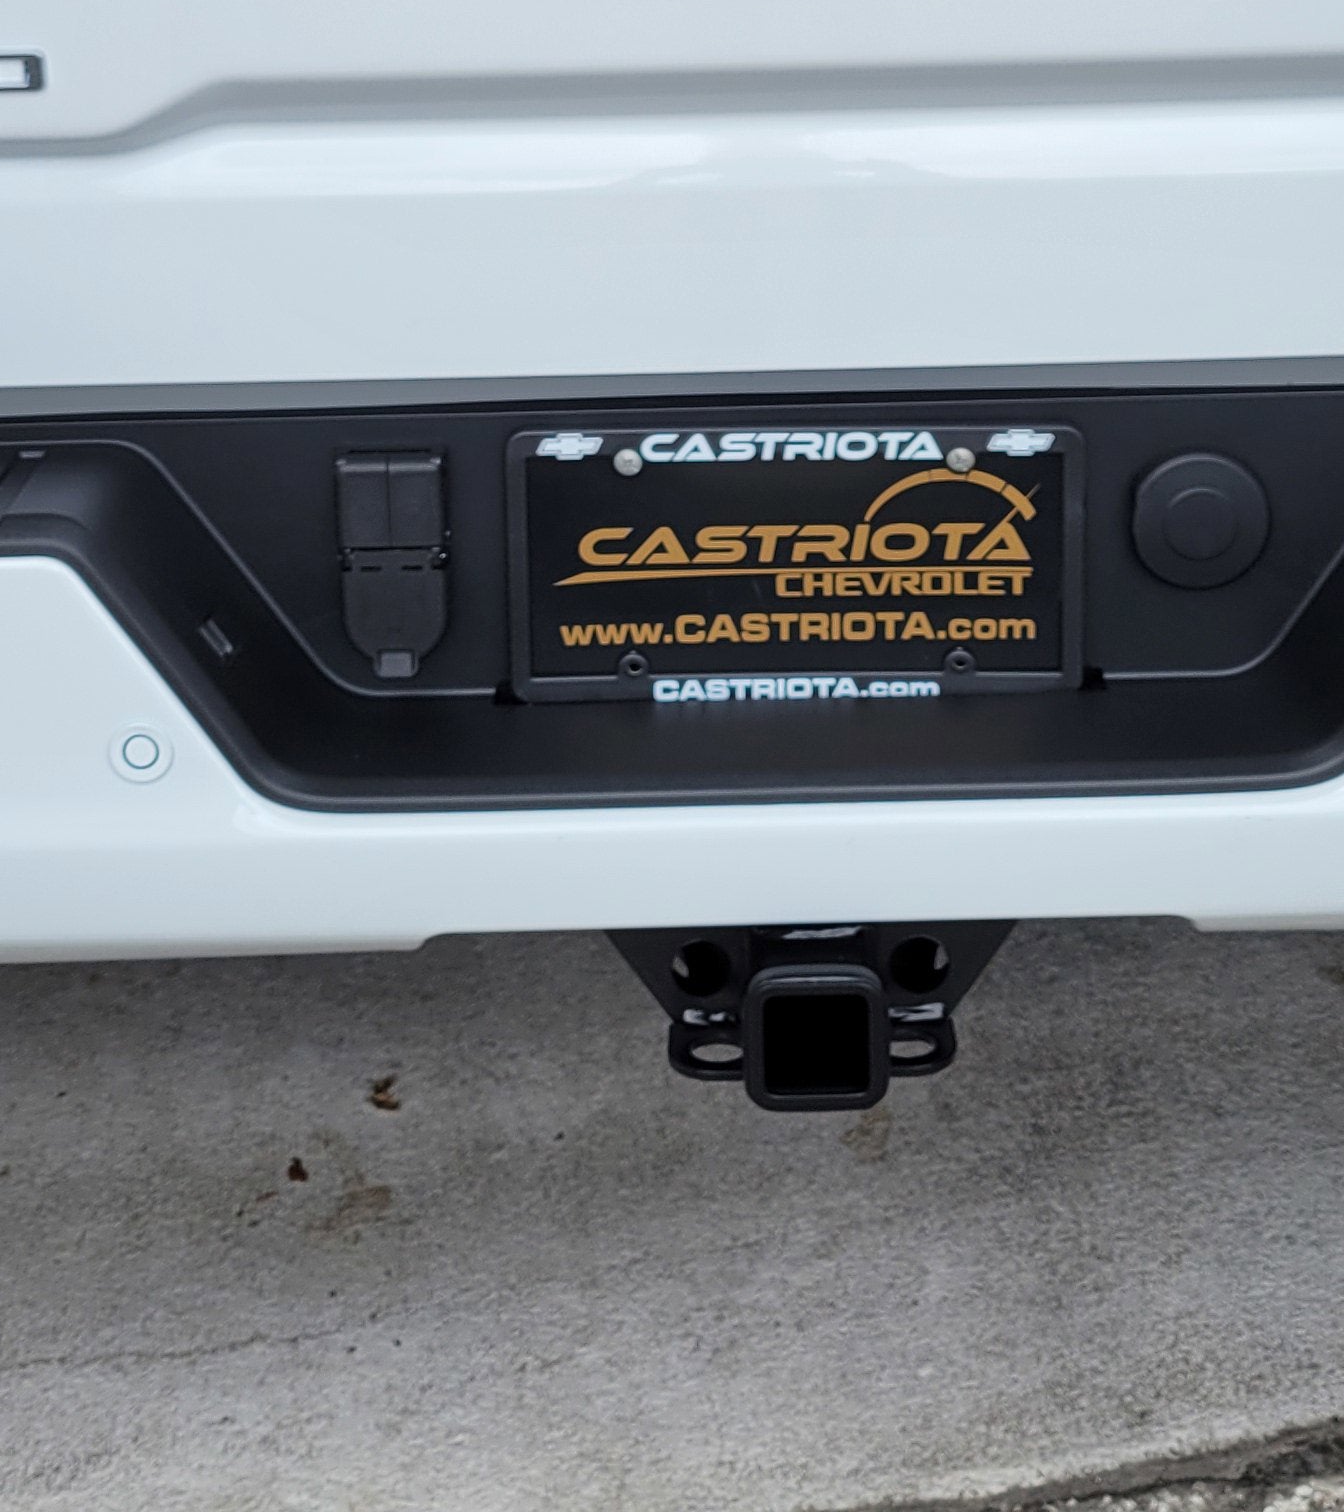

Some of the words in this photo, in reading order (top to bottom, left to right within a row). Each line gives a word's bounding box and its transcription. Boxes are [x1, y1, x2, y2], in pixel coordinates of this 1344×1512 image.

[640, 431, 943, 463] CASTRIOTA
[578, 522, 1031, 566] CASTRIOTA
[776, 571, 1032, 597] CHEVROLET
[559, 612, 1036, 647] www.CASTRIOTA.com
[653, 677, 941, 703] CASTRIOTA.com
